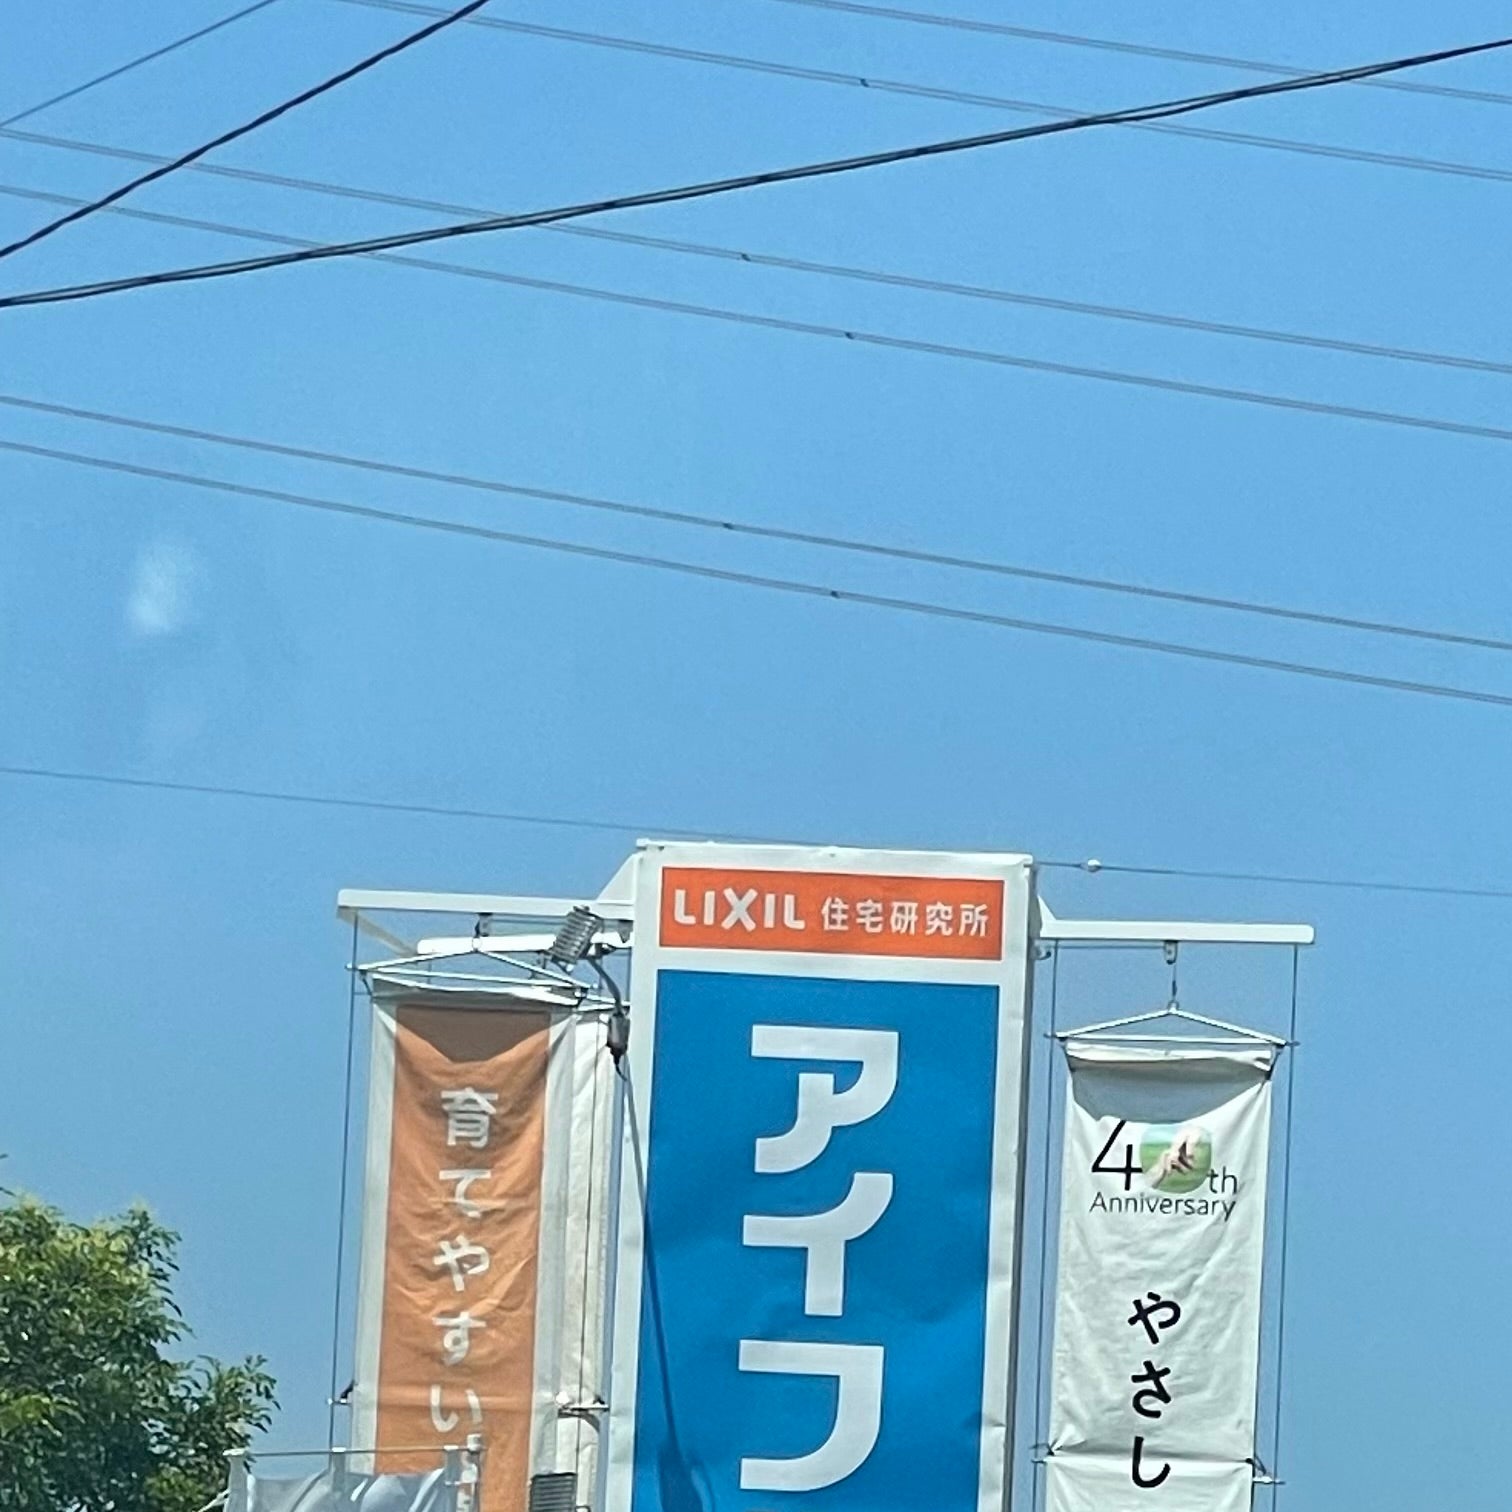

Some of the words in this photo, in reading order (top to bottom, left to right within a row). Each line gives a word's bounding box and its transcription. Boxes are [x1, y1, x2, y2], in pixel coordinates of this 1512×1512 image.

[674, 888, 805, 931] LIXIL
[821, 896, 989, 937] 住宅研究所
[1089, 1192, 1236, 1222] Anniversary
